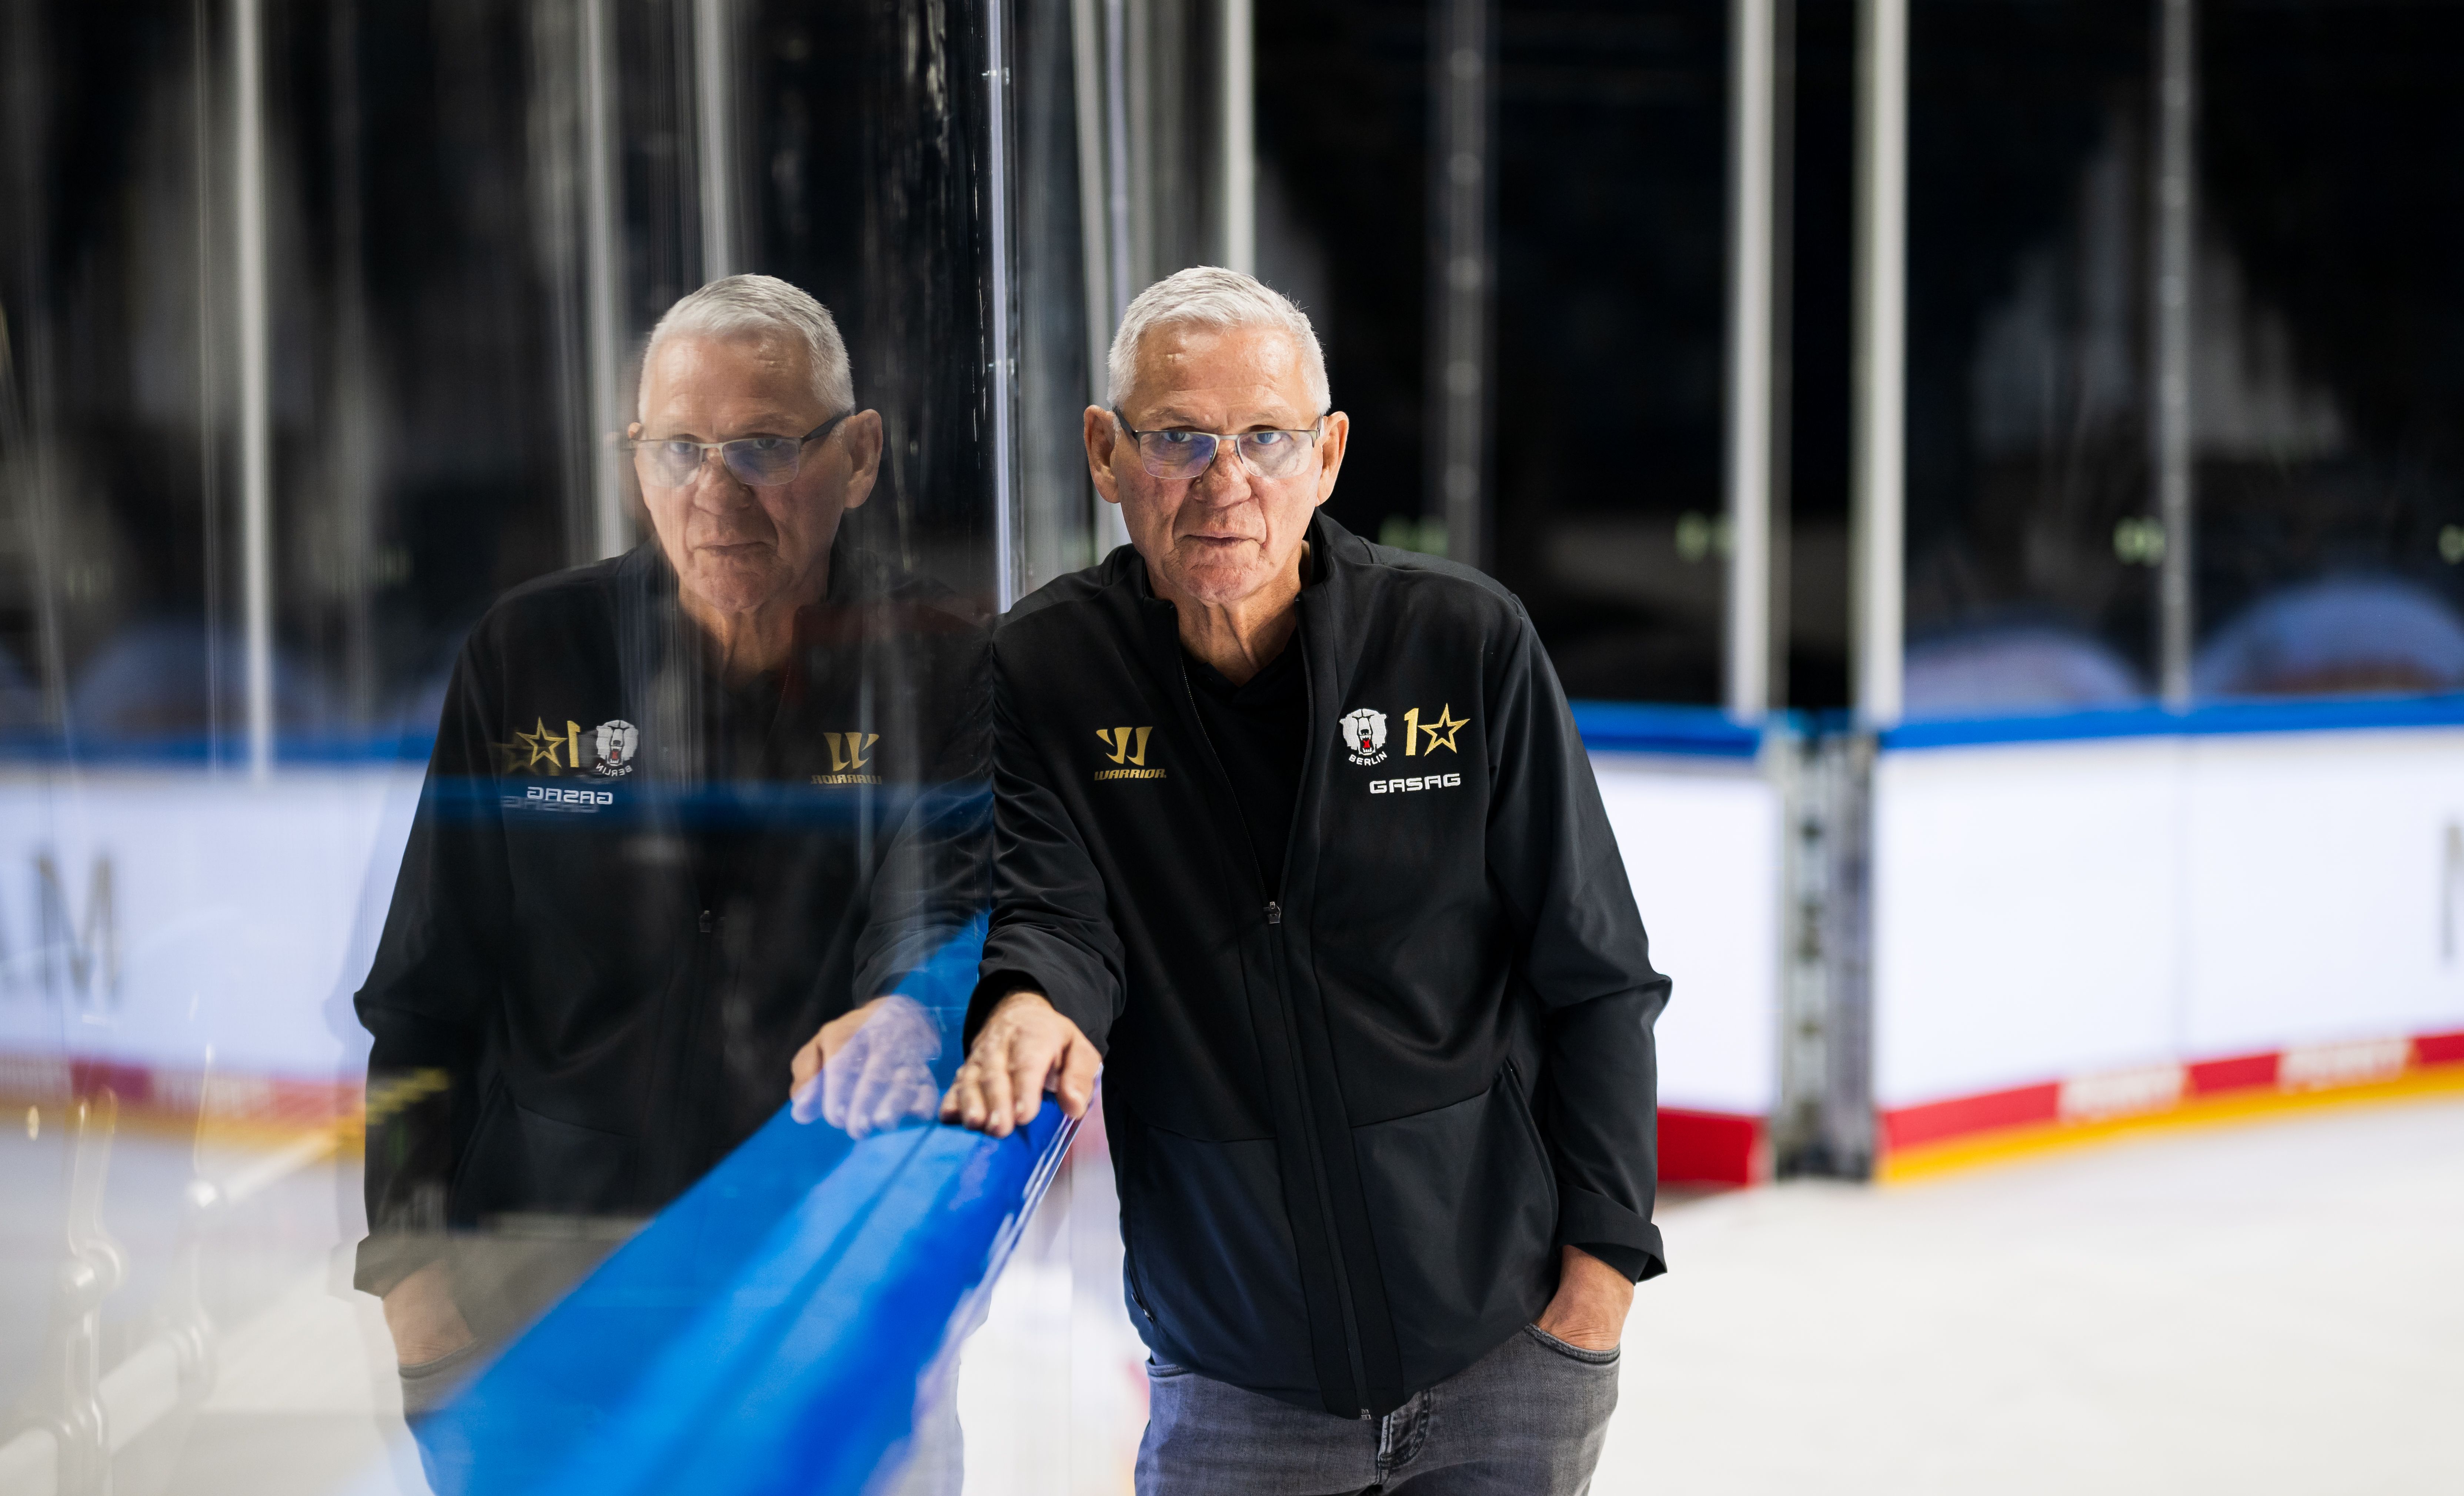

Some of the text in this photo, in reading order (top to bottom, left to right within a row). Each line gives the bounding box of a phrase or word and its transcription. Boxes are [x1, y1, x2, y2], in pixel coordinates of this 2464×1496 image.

[1348, 751, 1388, 766] BERLIN
[1094, 769, 1166, 781] WARRIOR
[1369, 773, 1461, 794] GASAG
